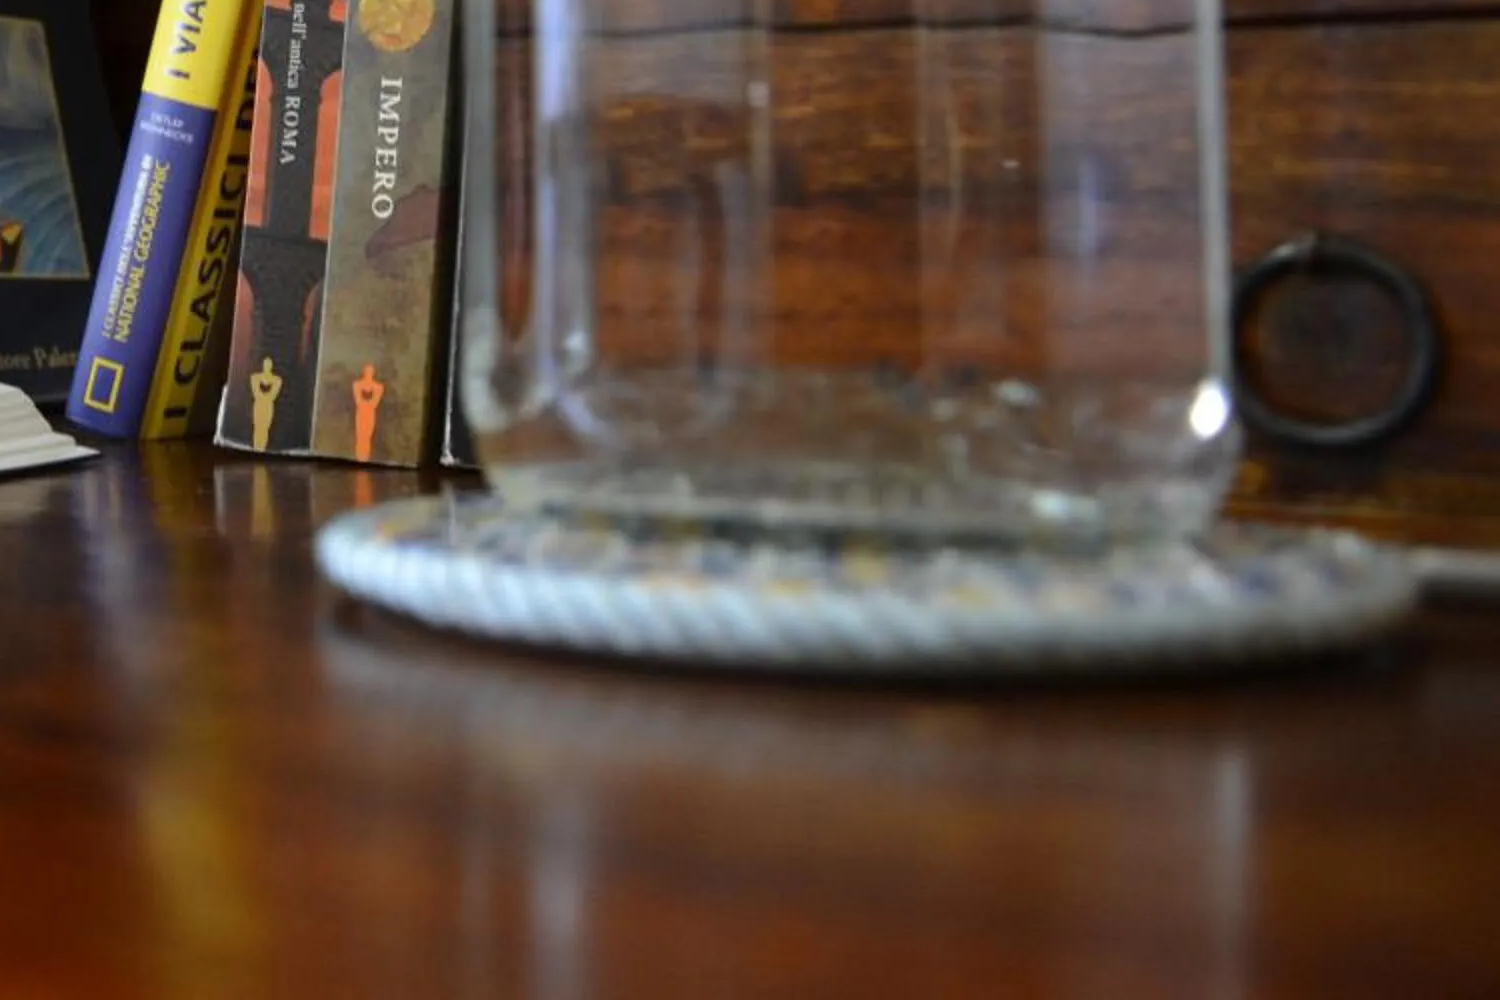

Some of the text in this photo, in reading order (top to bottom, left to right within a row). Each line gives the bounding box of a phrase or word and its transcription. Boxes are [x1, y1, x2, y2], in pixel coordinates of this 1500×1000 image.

[164, 66, 192, 82] I
[279, 95, 301, 165] ROMA
[371, 76, 404, 219] IMPERO
[113, 159, 171, 343] NATIONAL GEOGRAPHIC
[174, 152, 249, 386] CLASSICI
[32, 345, 78, 370] Paler
[164, 406, 188, 420] I
